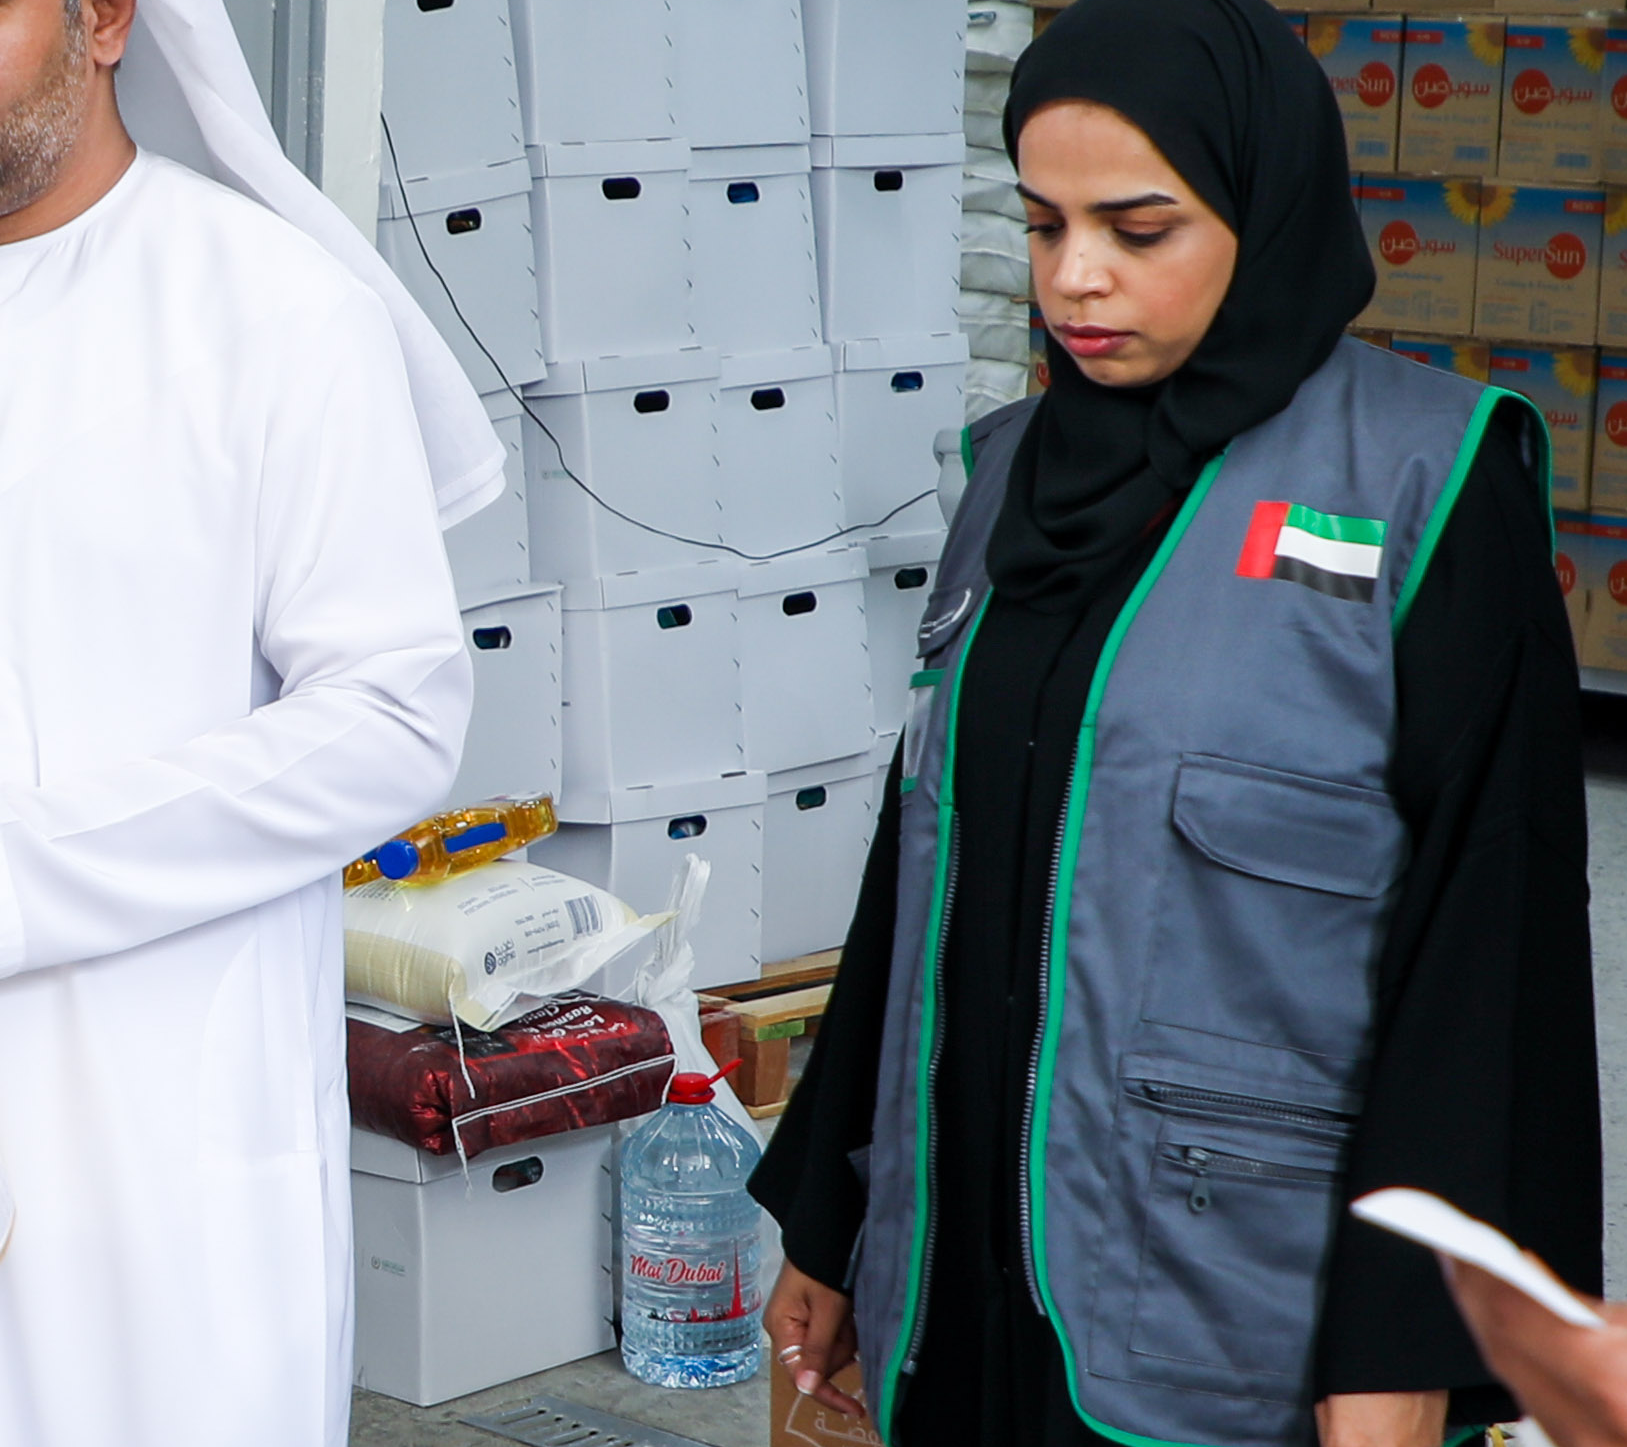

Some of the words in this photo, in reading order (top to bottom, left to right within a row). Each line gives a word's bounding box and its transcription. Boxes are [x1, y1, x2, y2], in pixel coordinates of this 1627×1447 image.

[1493, 239, 1582, 267] SuperSun
[629, 1254, 663, 1280] Mai
[666, 1257, 725, 1285] Dubai
